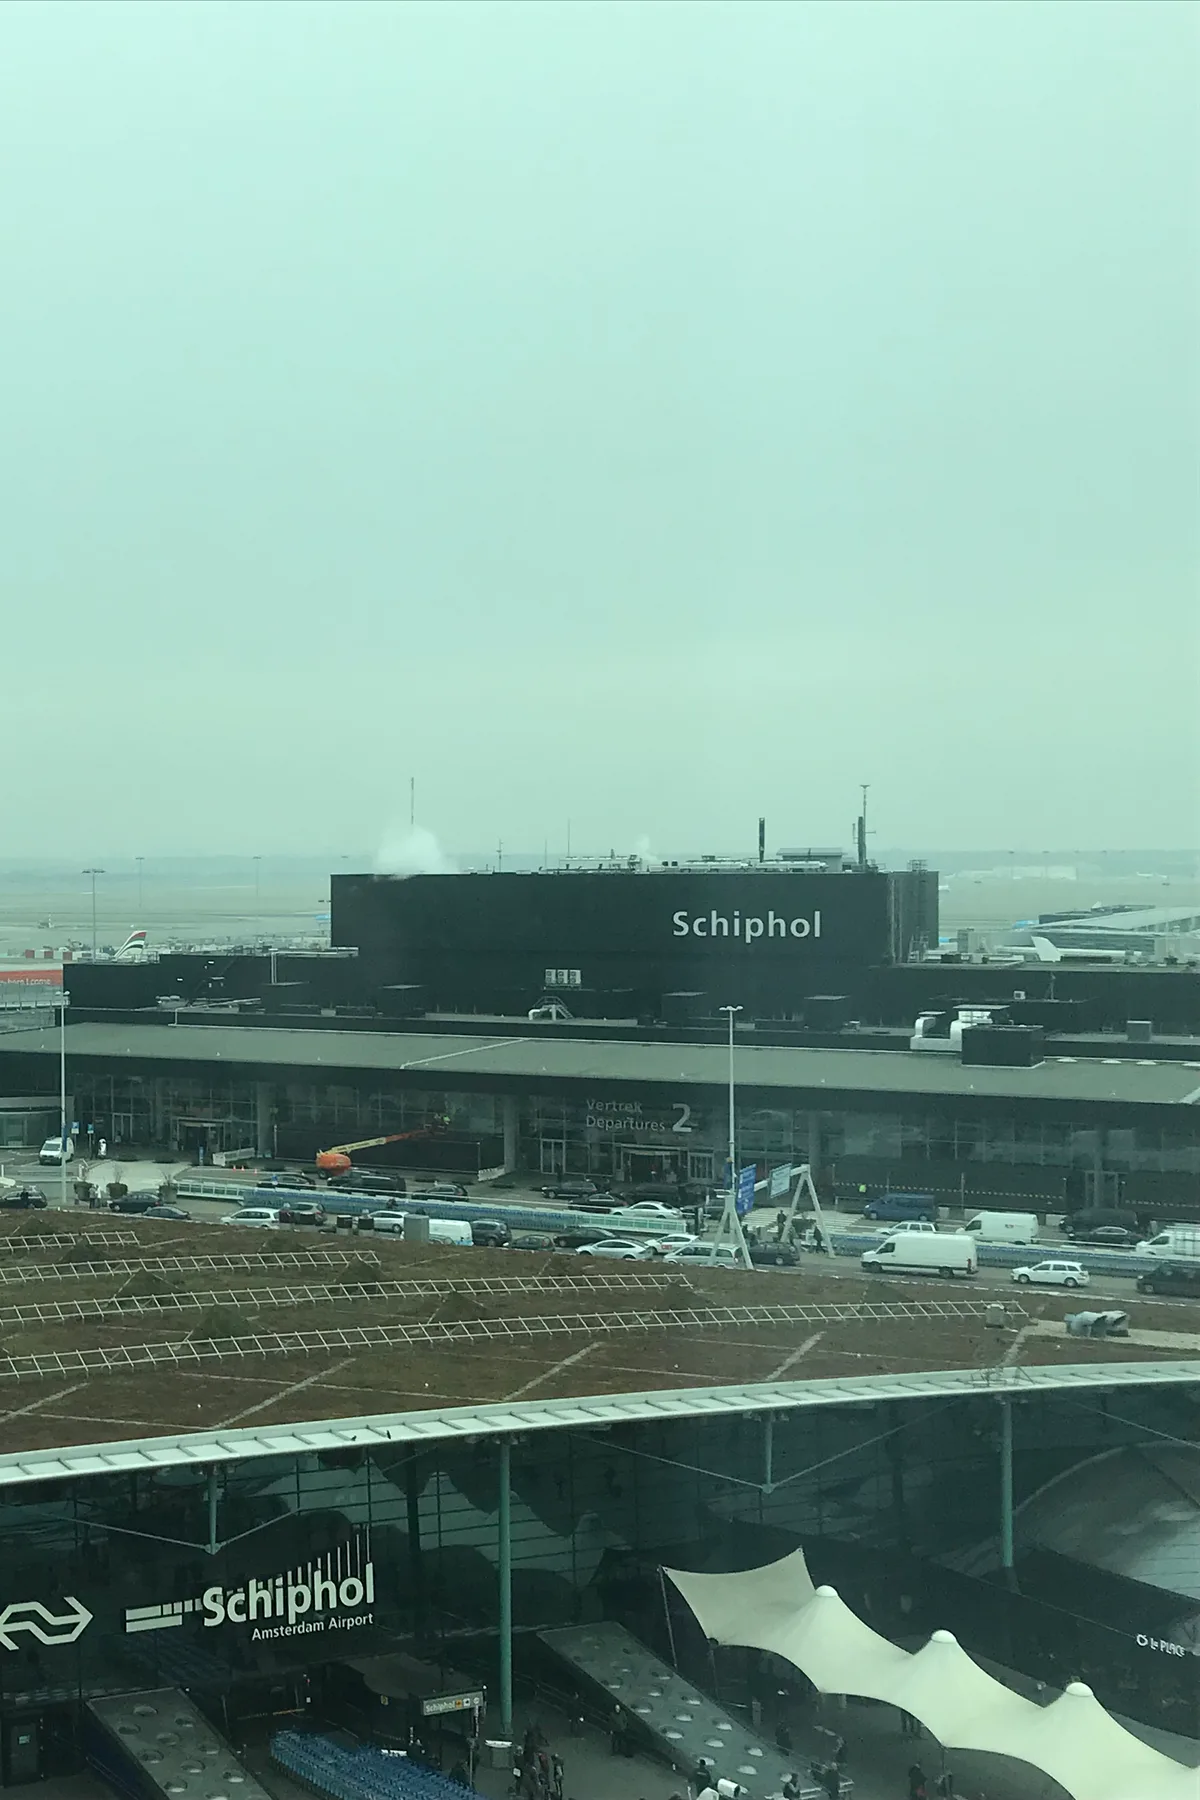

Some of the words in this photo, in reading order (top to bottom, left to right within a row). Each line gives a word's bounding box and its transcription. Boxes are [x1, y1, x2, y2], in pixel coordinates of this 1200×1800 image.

[672, 910, 821, 943] Schiphol
[586, 1099, 643, 1114] Vertrek
[586, 1115, 665, 1131] Departures
[672, 1103, 692, 1132] 2
[203, 1562, 375, 1627] Schiphol
[252, 1621, 325, 1641] Amsterdam
[328, 1612, 374, 1630] Airport
[425, 1700, 456, 1712] Schiphol
